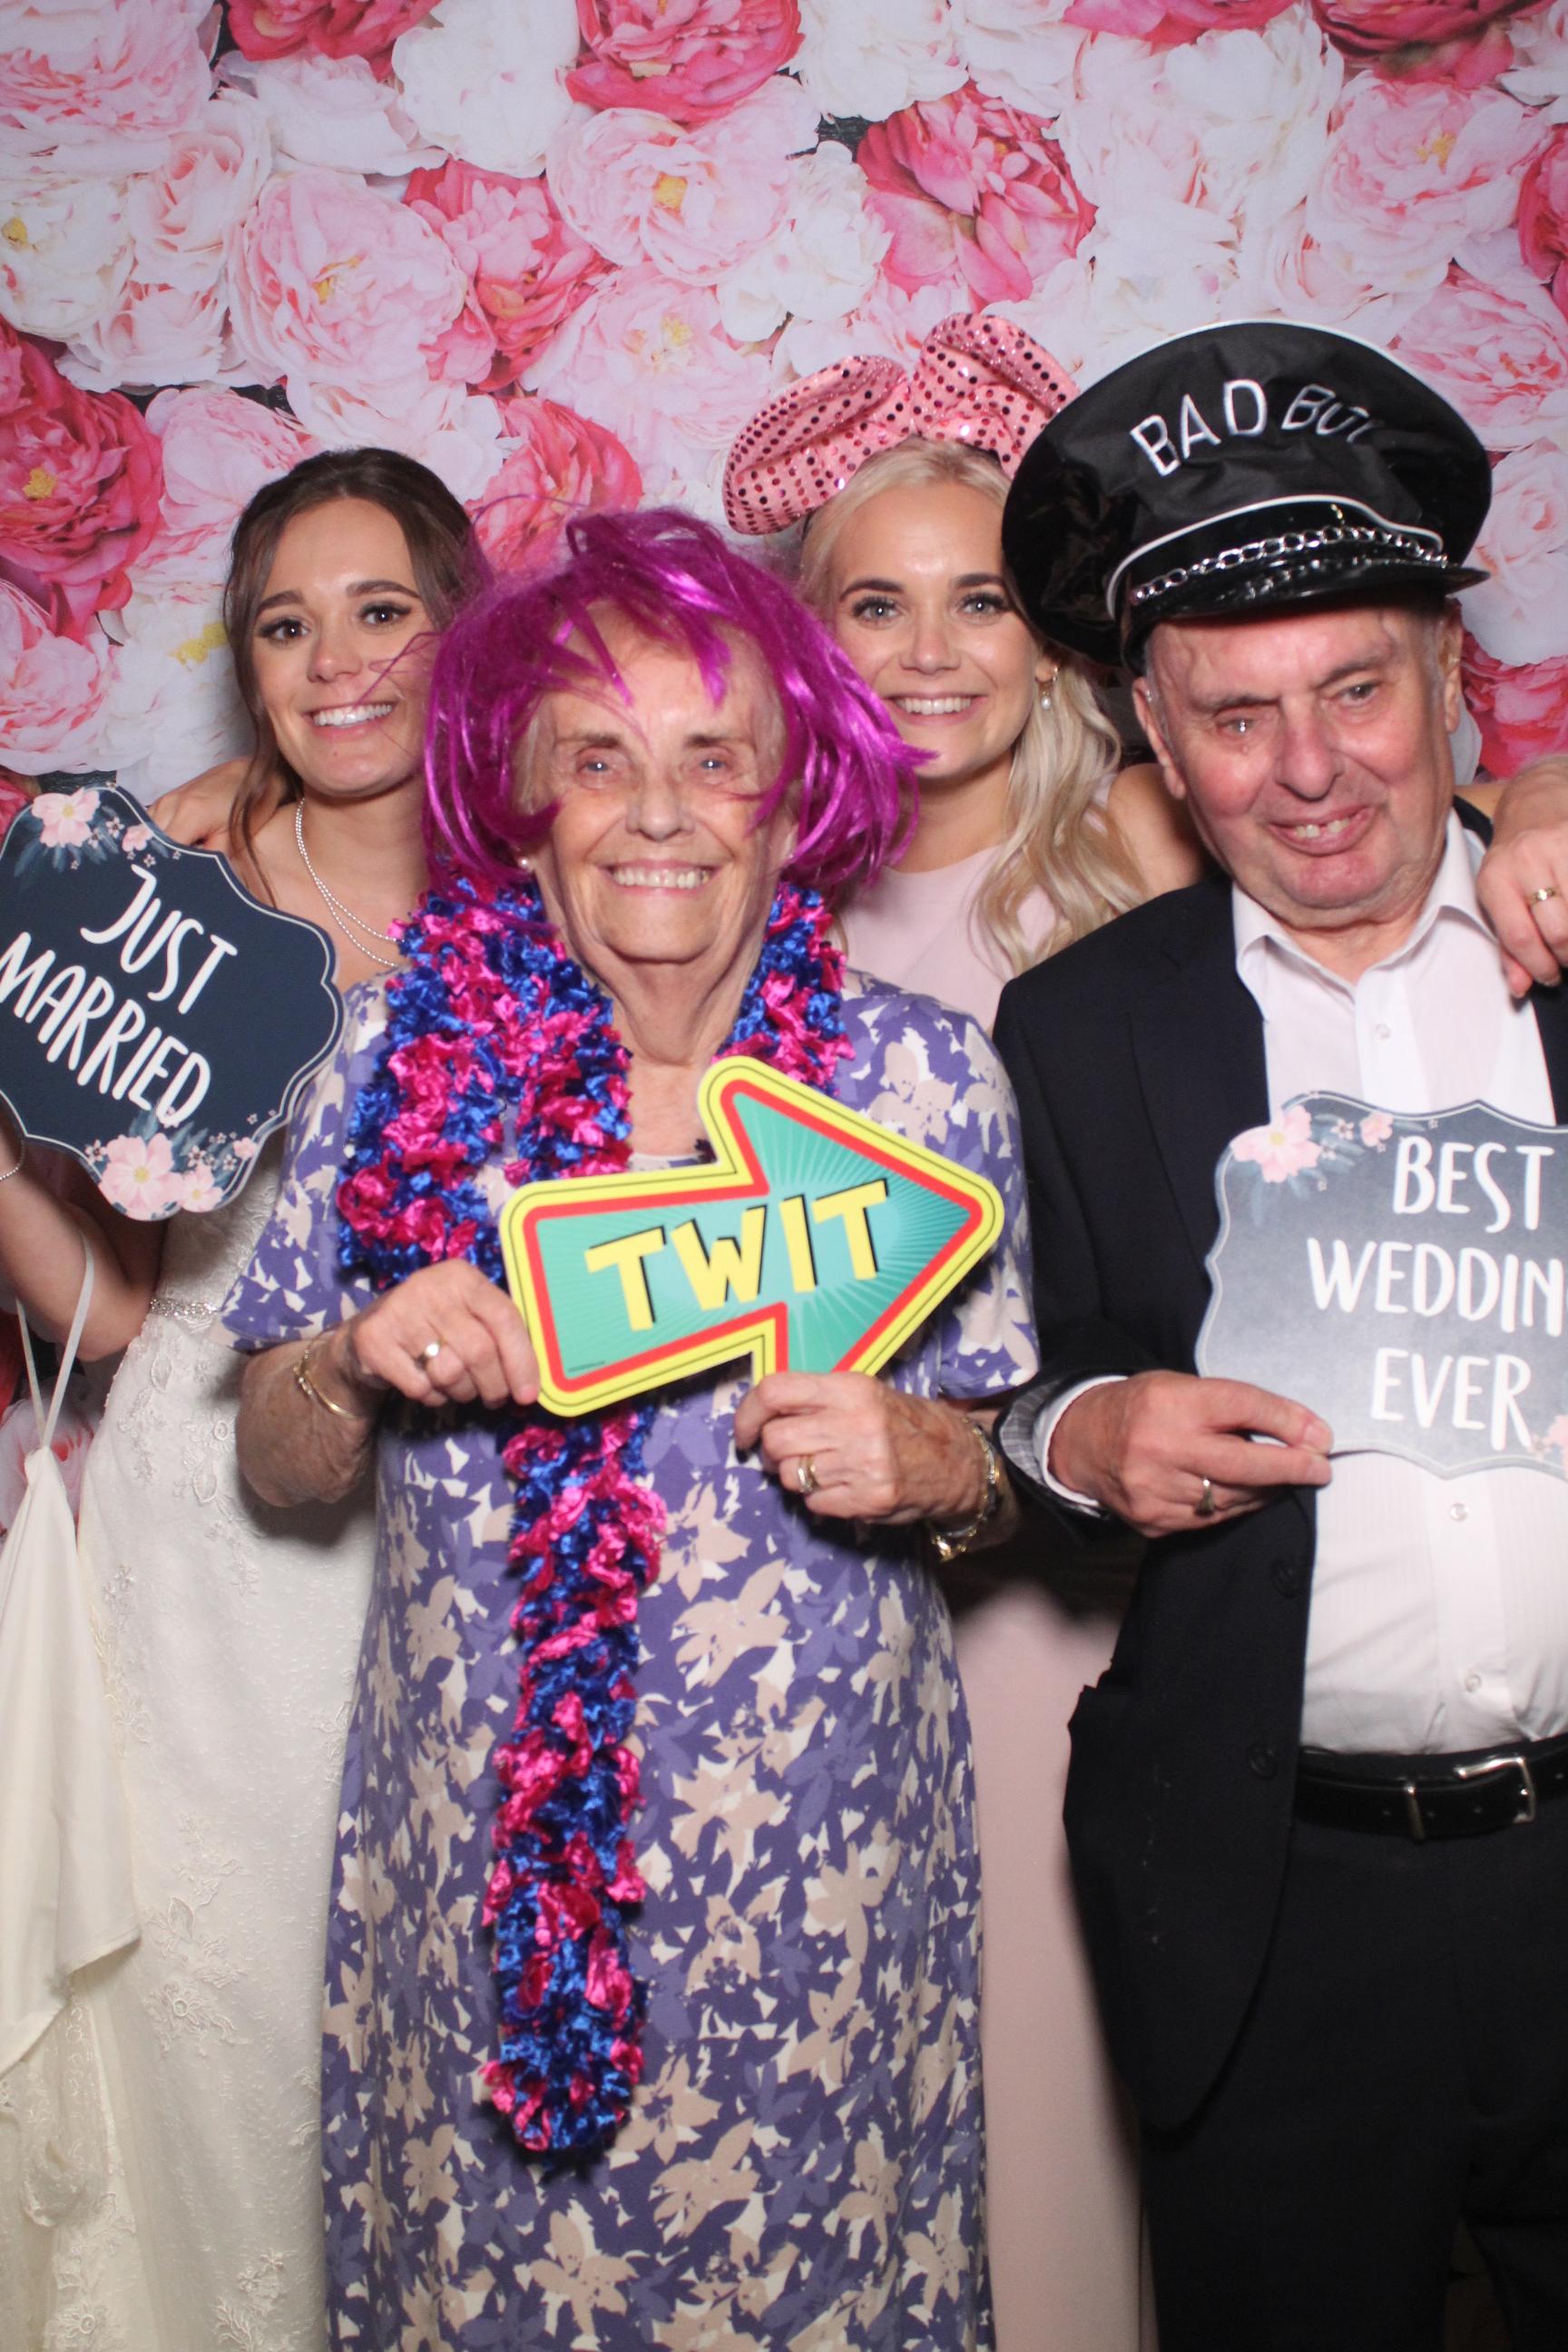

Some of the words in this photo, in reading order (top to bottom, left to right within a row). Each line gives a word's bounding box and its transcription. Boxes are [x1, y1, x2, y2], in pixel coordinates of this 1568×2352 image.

[1130, 378, 1268, 477] BAD
[80, 863, 238, 1014] JUST
[0, 931, 211, 1128] MARRIED
[1392, 1135, 1554, 1233] BEST
[583, 1178, 889, 1332] TWIT
[1306, 1237, 1568, 1338] WEDDIN
[1370, 1348, 1533, 1451] EVER
